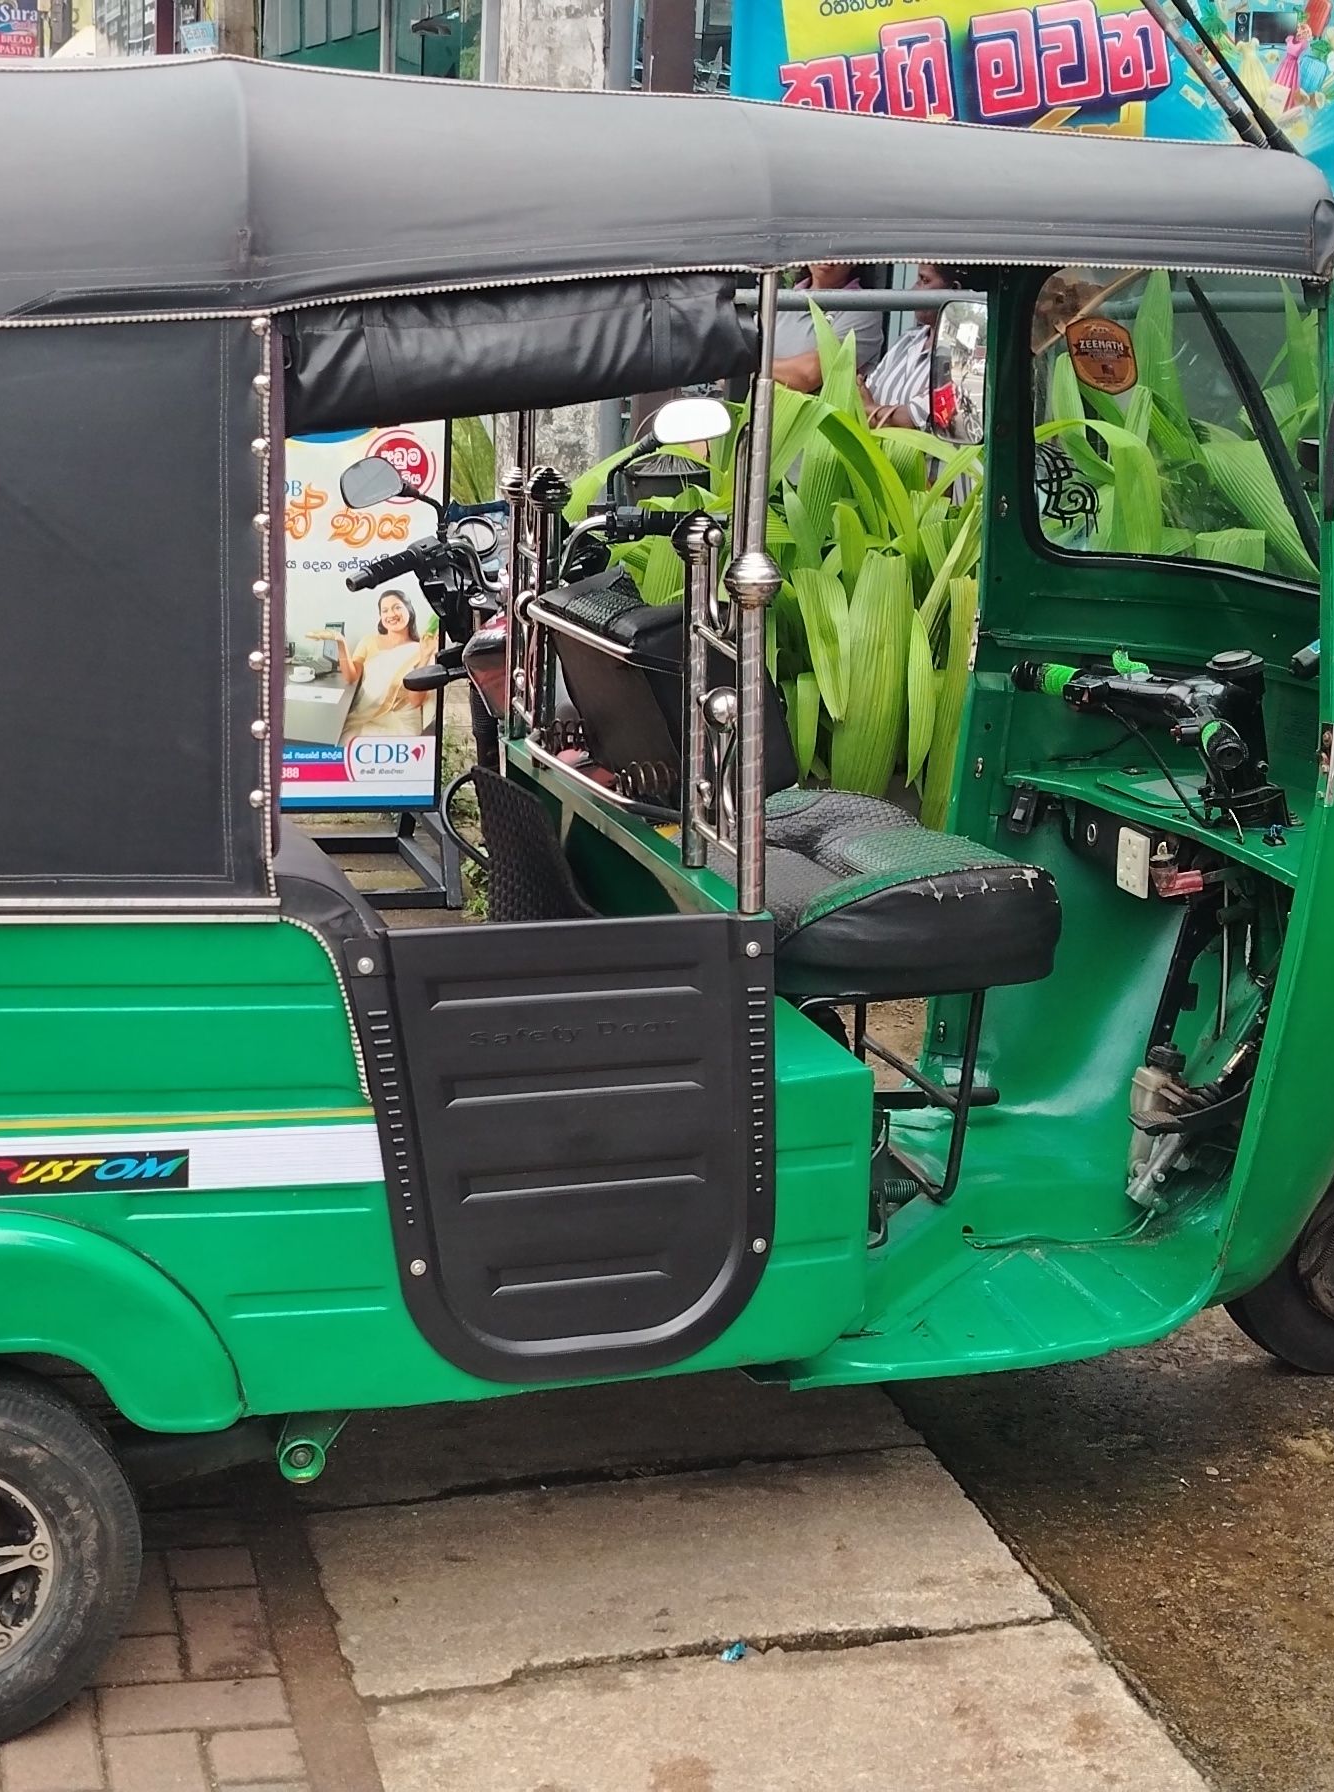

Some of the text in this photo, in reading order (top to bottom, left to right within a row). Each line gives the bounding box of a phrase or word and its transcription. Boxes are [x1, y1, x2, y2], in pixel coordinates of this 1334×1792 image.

[0, 4, 38, 22] Sura
[0, 34, 33, 44] BREAD
[0, 44, 34, 56] PASTRY
[355, 743, 409, 764] CDB
[469, 1020, 679, 1047] Safety Door
